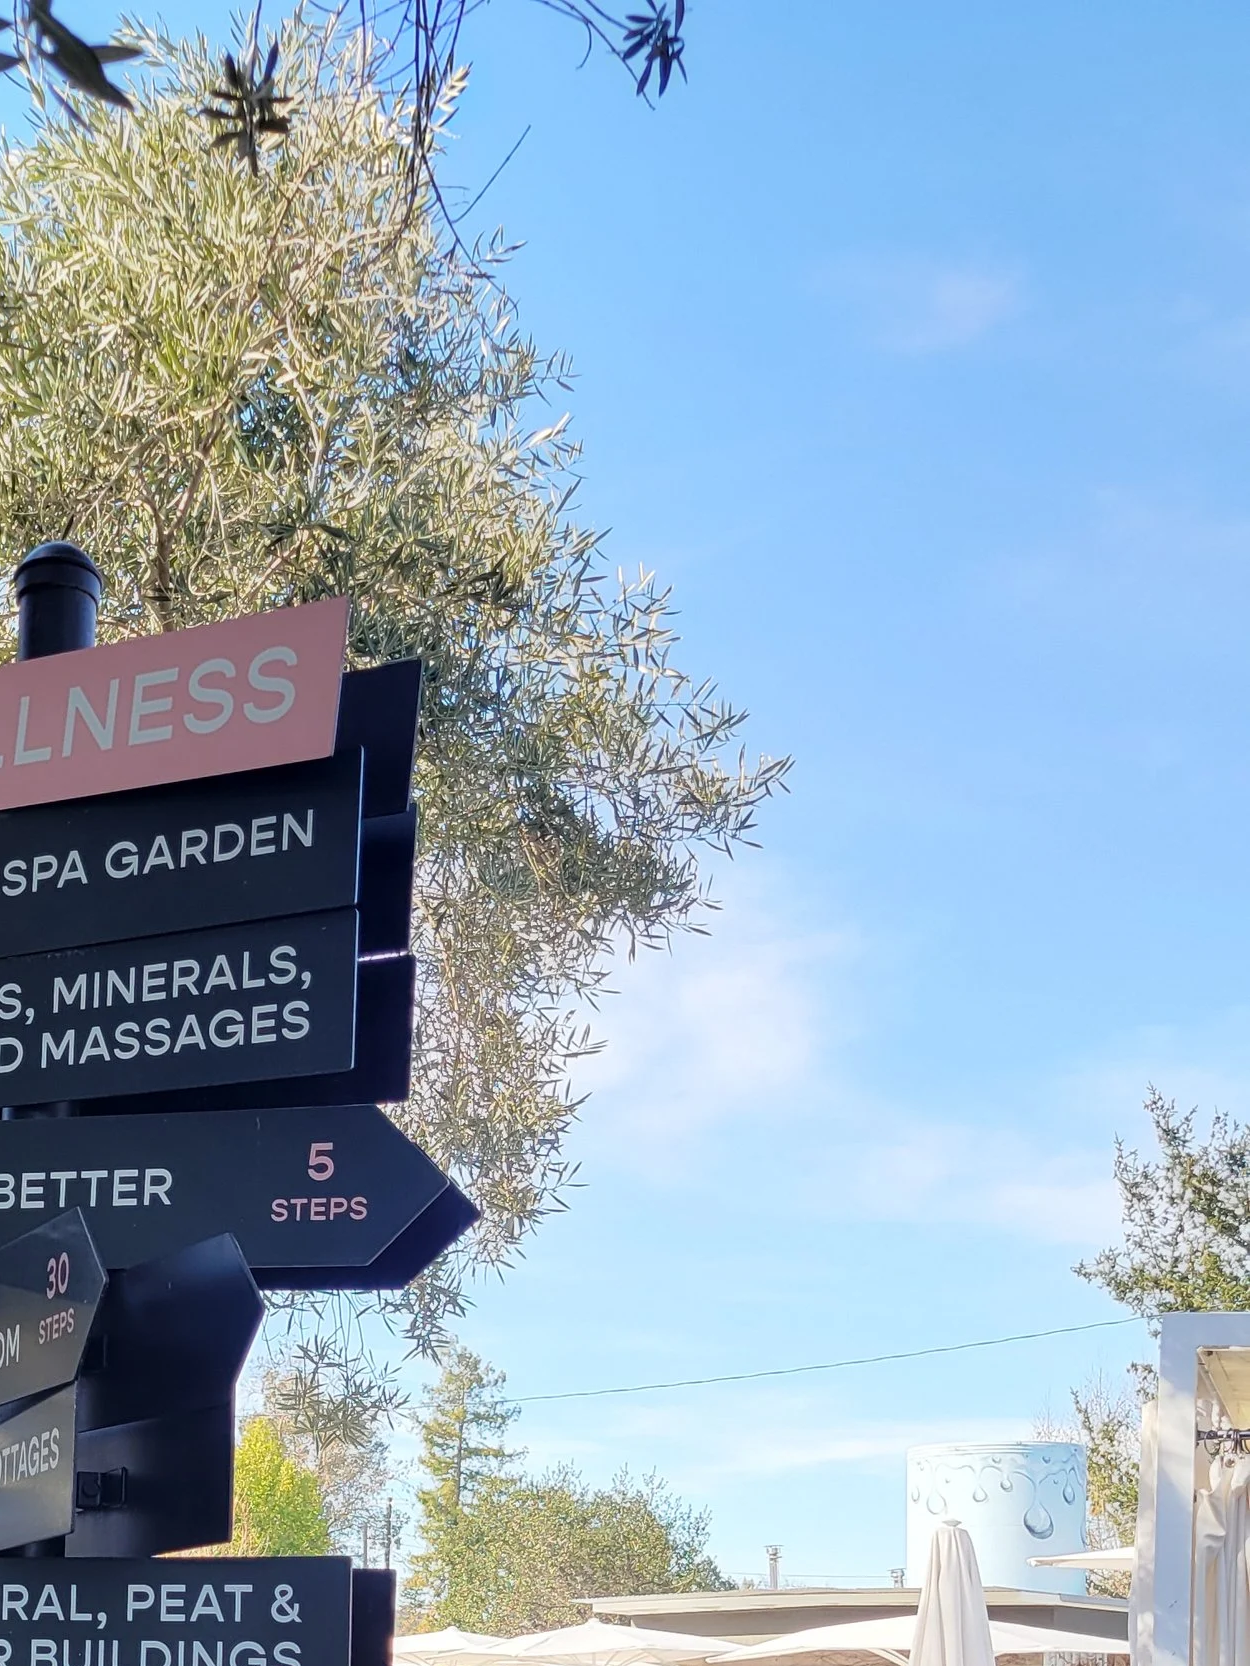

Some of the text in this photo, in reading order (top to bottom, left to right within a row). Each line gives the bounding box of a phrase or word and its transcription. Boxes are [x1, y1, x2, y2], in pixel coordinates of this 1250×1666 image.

[2, 810, 315, 898] SPA GARDEN
[53, 944, 313, 1014] MINERALS,
[41, 999, 310, 1070] MASSAGES
[307, 1142, 335, 1180] 5
[270, 1196, 369, 1223] STEPS
[46, 1252, 70, 1300] 30
[38, 1308, 75, 1345] STEPS
[127, 1584, 253, 1622] PEAT
[273, 1585, 302, 1623] &
